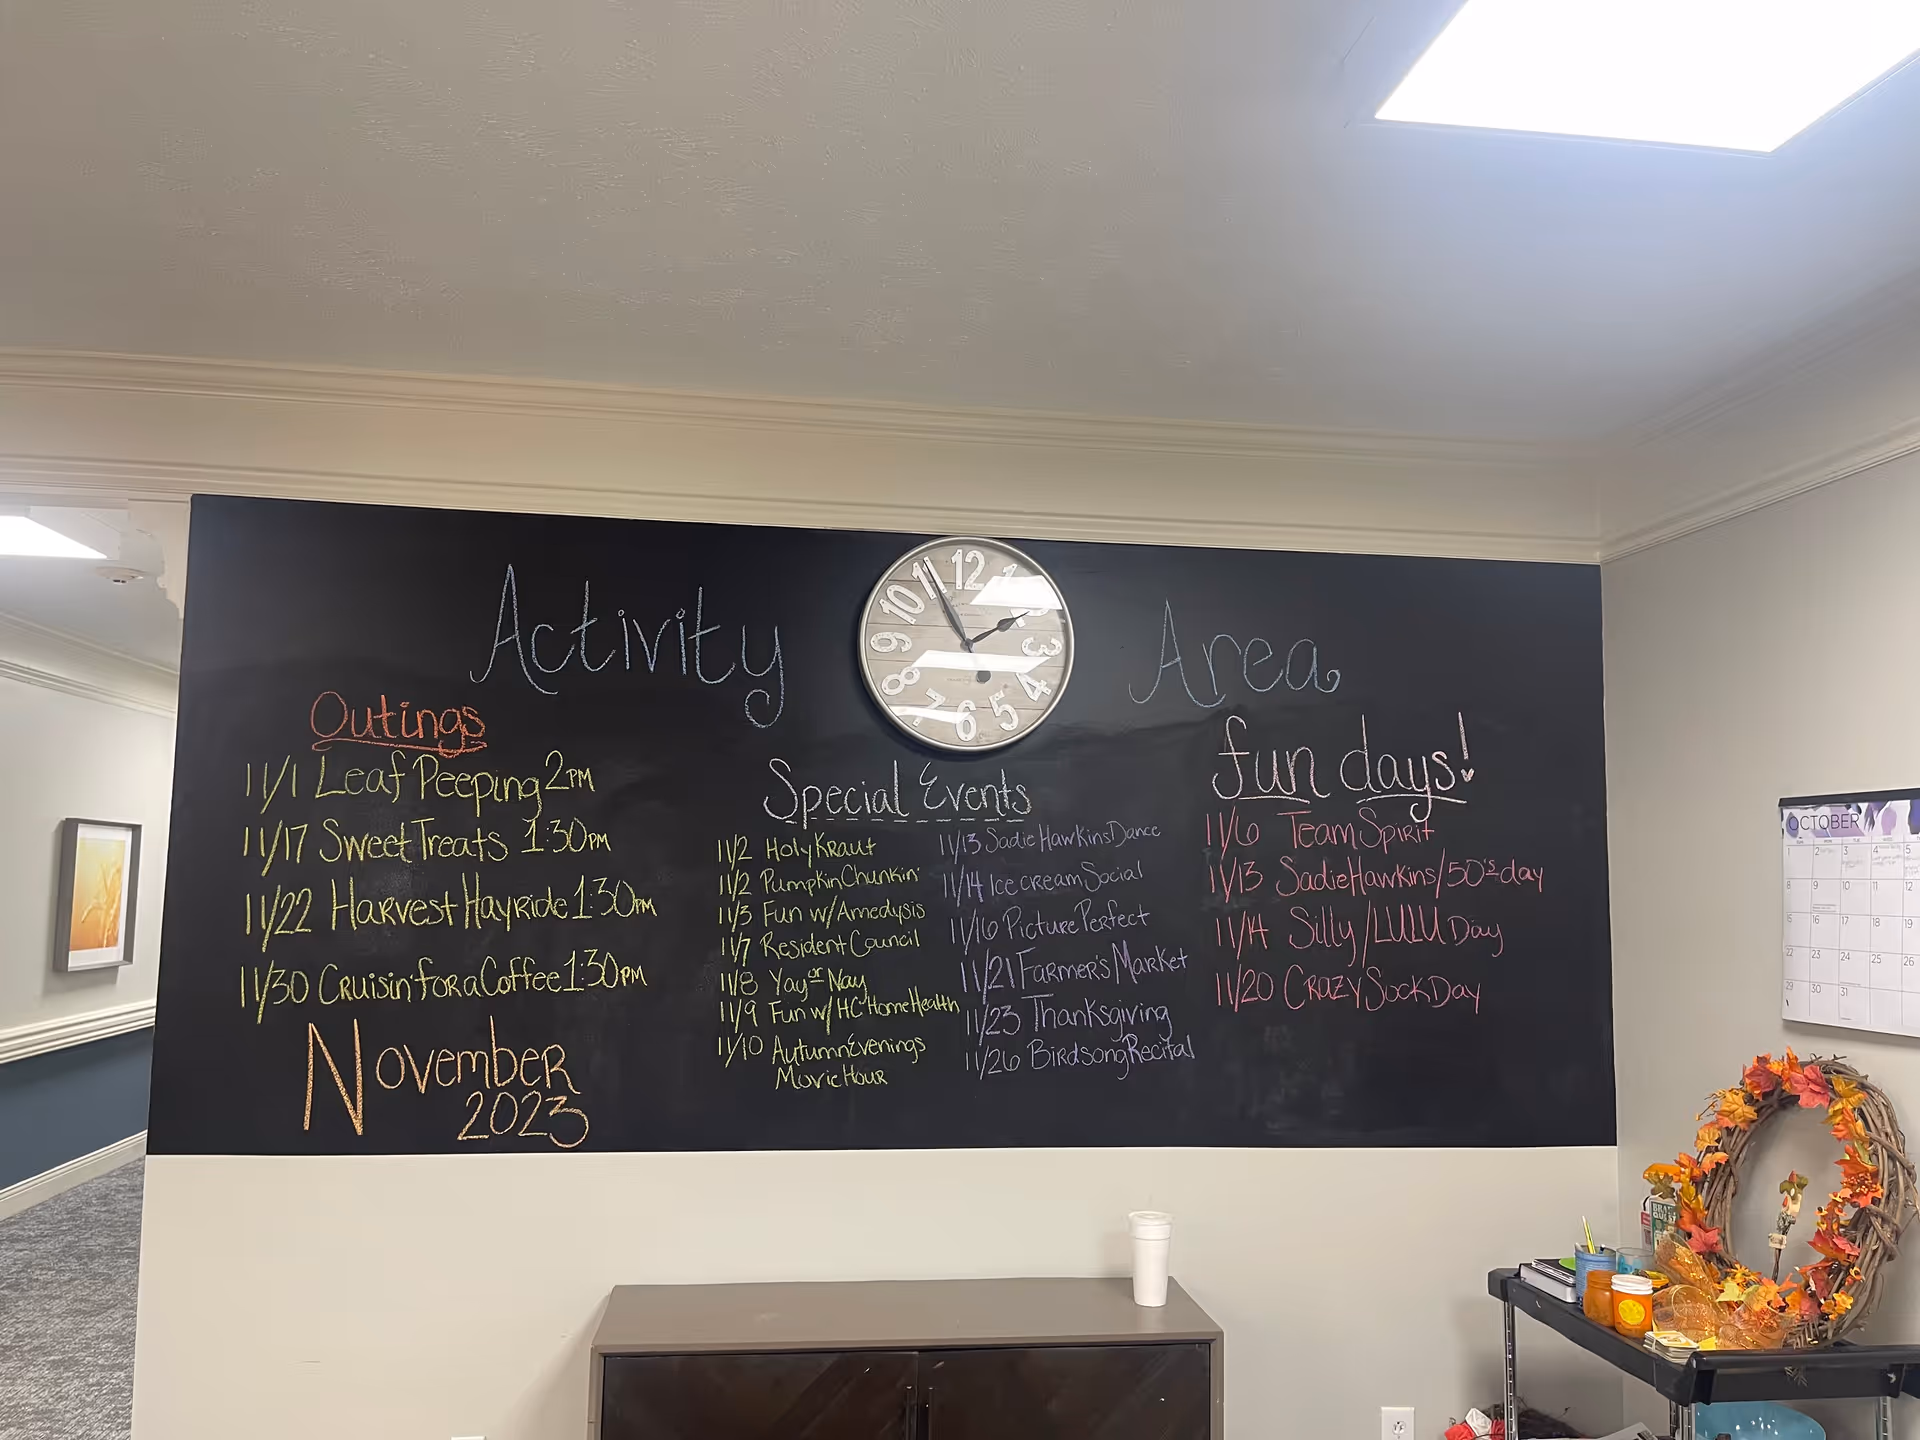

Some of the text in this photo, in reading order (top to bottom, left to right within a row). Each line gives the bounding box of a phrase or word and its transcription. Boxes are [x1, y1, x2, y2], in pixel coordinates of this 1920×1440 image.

[911, 556, 948, 601] 11
[951, 549, 987, 590] 12
[879, 584, 926, 625] 10
[469, 563, 1341, 728] Activity Area
[870, 631, 913, 653] 9
[1021, 636, 1063, 657] 3
[881, 666, 921, 696] 8
[1015, 671, 1052, 702] 4
[310, 691, 488, 758] Outings
[955, 699, 978, 742] 6
[988, 690, 1019, 731] 5
[246, 754, 297, 814] 11/1
[315, 750, 406, 803] Leaf
[412, 753, 543, 822] Peeping
[763, 757, 1032, 830] Special Events
[939, 829, 982, 865] 11/13
[985, 827, 1036, 854] Sadie
[1106, 820, 1162, 848] Dance
[1205, 806, 1435, 861] 11/6 Team Spirit
[1788, 813, 1860, 831] OCTOBER
[243, 820, 308, 877] 11/17
[318, 818, 413, 863] Sweet
[410, 817, 509, 862] Treats
[718, 834, 752, 871] 11/2
[766, 836, 812, 868] Holy
[1814, 847, 1820, 856] 2
[1843, 845, 1849, 856] 3
[1872, 845, 1879, 854] 4
[1905, 844, 1911, 855] 5
[719, 869, 752, 902] 11/2
[942, 864, 984, 908] 11/14
[990, 873, 1018, 896] Ice
[1080, 860, 1143, 892] Social
[1208, 857, 1263, 903] 11/13
[1276, 856, 1350, 897] Sadie
[1500, 858, 1544, 893] day
[1786, 880, 1913, 892] 8 9 10 11 12
[246, 884, 313, 953] 11/22
[331, 876, 459, 931] Harvest
[719, 900, 752, 933] 11/3
[763, 900, 803, 928] Fun
[950, 908, 998, 955] 11/16
[1216, 910, 1269, 960] 11/14
[1447, 915, 1504, 957] Day
[1812, 914, 1820, 925] 16
[1841, 916, 1849, 926] 17
[1872, 917, 1881, 928] 18
[1904, 918, 1913, 929] 19
[721, 928, 920, 967] 11/7 Resident Council
[1785, 947, 1914, 967] 22 23 24 25 26
[240, 960, 309, 1024] 11/30
[463, 975, 483, 998] a
[480, 955, 561, 997] Coffee
[721, 966, 868, 1005] 11/8 Yay or Nay
[960, 948, 1015, 1005] 11/21
[1112, 939, 1188, 985] Market
[1216, 963, 1274, 1013] 11/20
[1365, 965, 1431, 1012] Sock
[1429, 974, 1482, 1015] Day
[1785, 980, 1848, 997] 29 30 31
[720, 999, 758, 1033] 11/9
[768, 1001, 806, 1025] Fun
[966, 993, 1173, 1046] 11/23 Thanksgiving
[718, 1033, 927, 1068] 11/10 Autumn Evenings
[965, 1033, 1195, 1080] 11/26 Birdsong Recital
[303, 1015, 581, 1136] November
[775, 1065, 842, 1090] Movie
[457, 1090, 589, 1149] 2023
